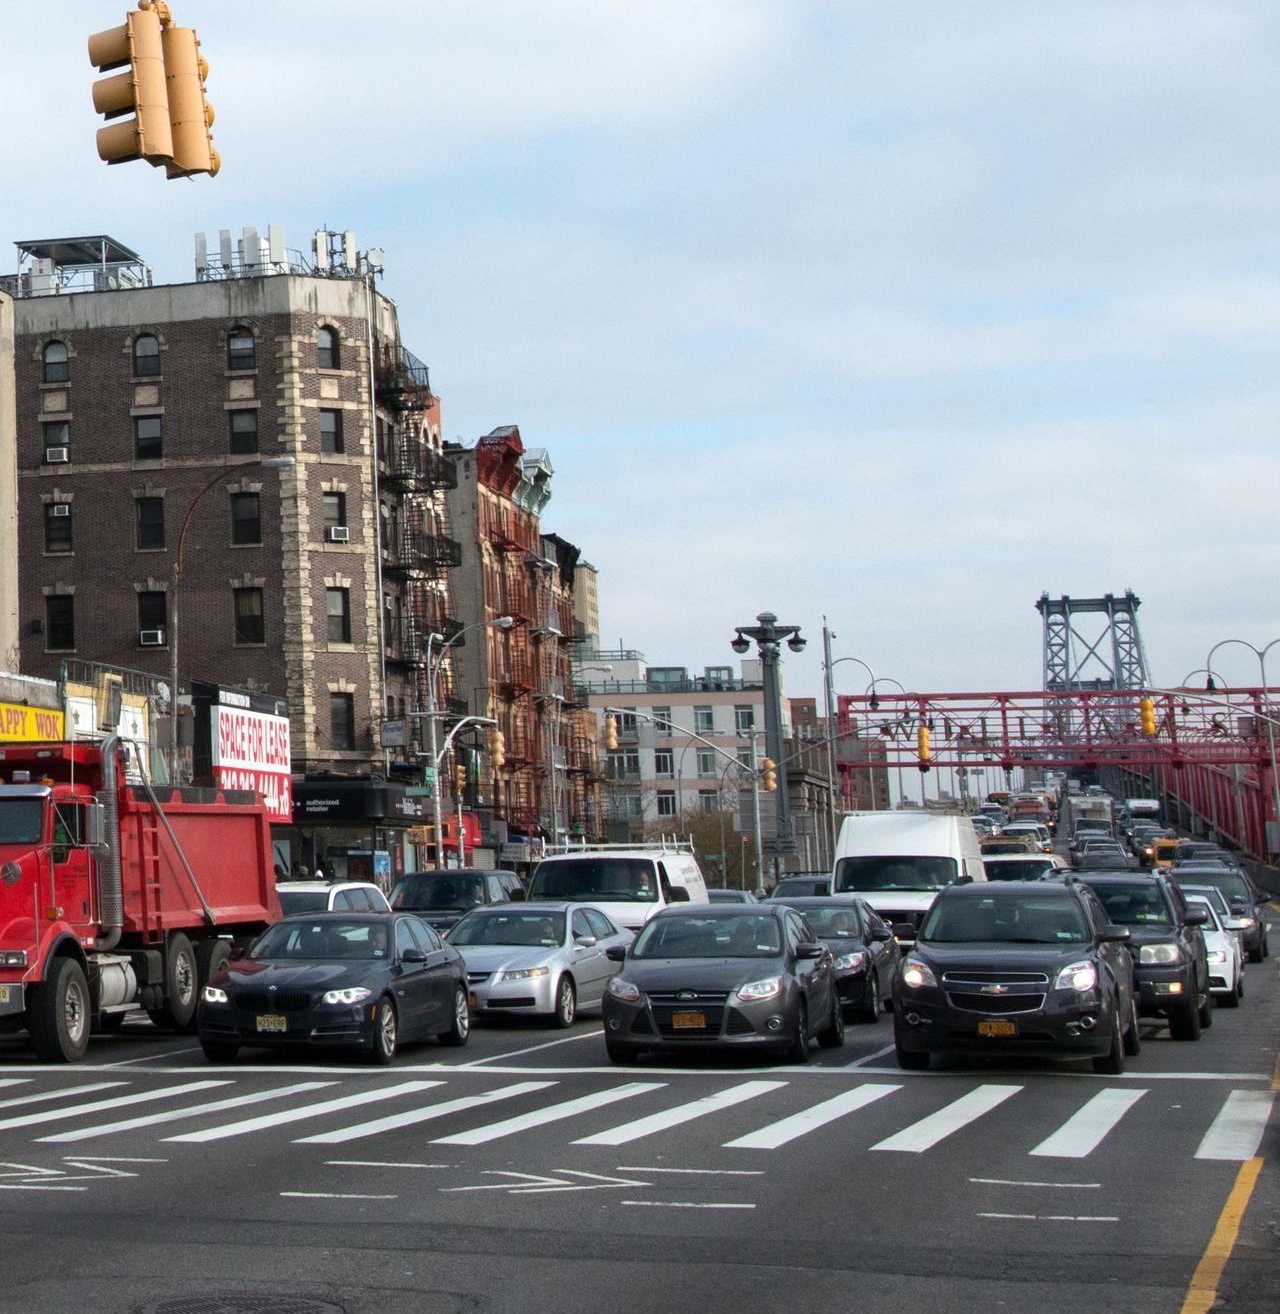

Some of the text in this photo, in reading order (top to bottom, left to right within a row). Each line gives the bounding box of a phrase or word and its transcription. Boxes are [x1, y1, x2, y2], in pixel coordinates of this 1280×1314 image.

[35, 712, 60, 741] WOK
[219, 711, 288, 767] SPACE FOR LEASE
[306, 799, 340, 807] authorized
[306, 805, 329, 813] retailer
